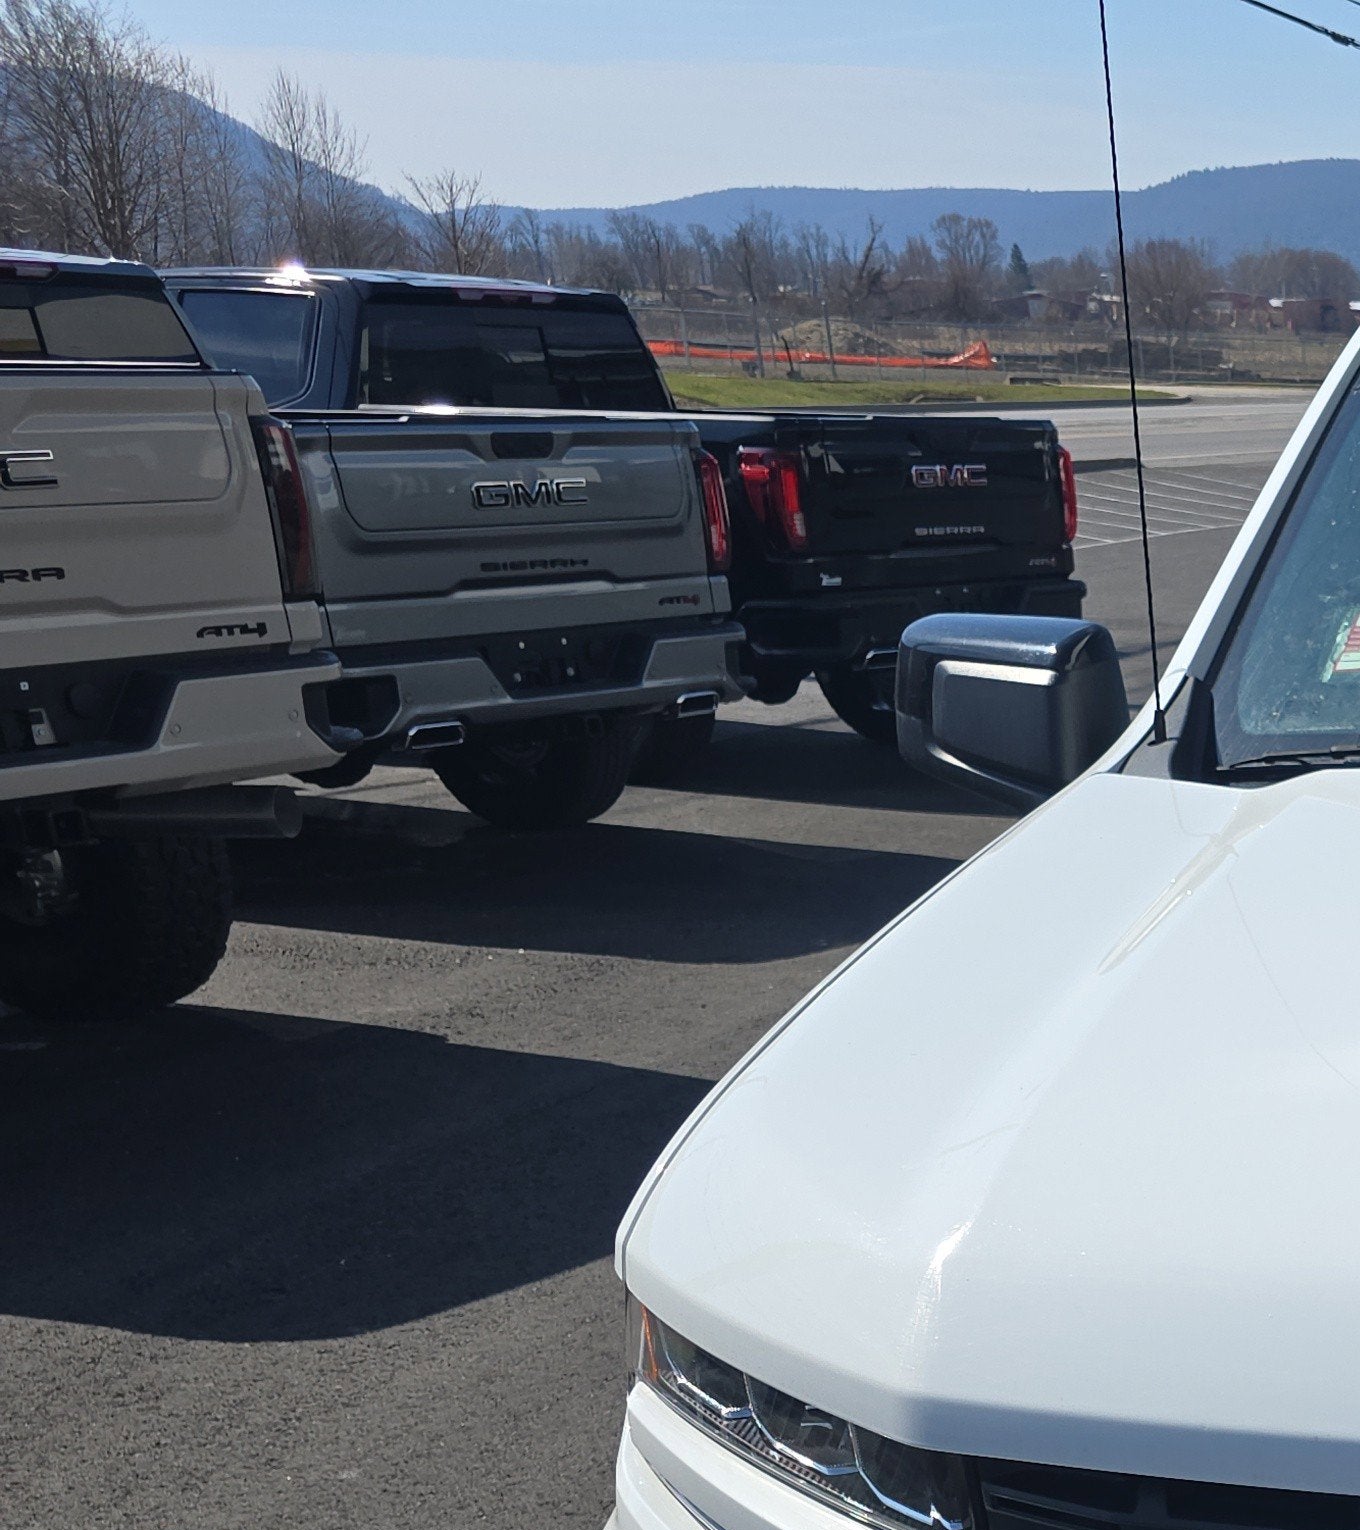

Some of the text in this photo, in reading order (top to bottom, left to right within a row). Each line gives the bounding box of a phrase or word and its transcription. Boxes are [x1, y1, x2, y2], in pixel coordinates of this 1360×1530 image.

[911, 464, 988, 488] GMC
[471, 477, 589, 509] GMC
[914, 525, 985, 536] SIERRA
[480, 558, 590, 572] SIERRA
[196, 622, 268, 638] AT4
